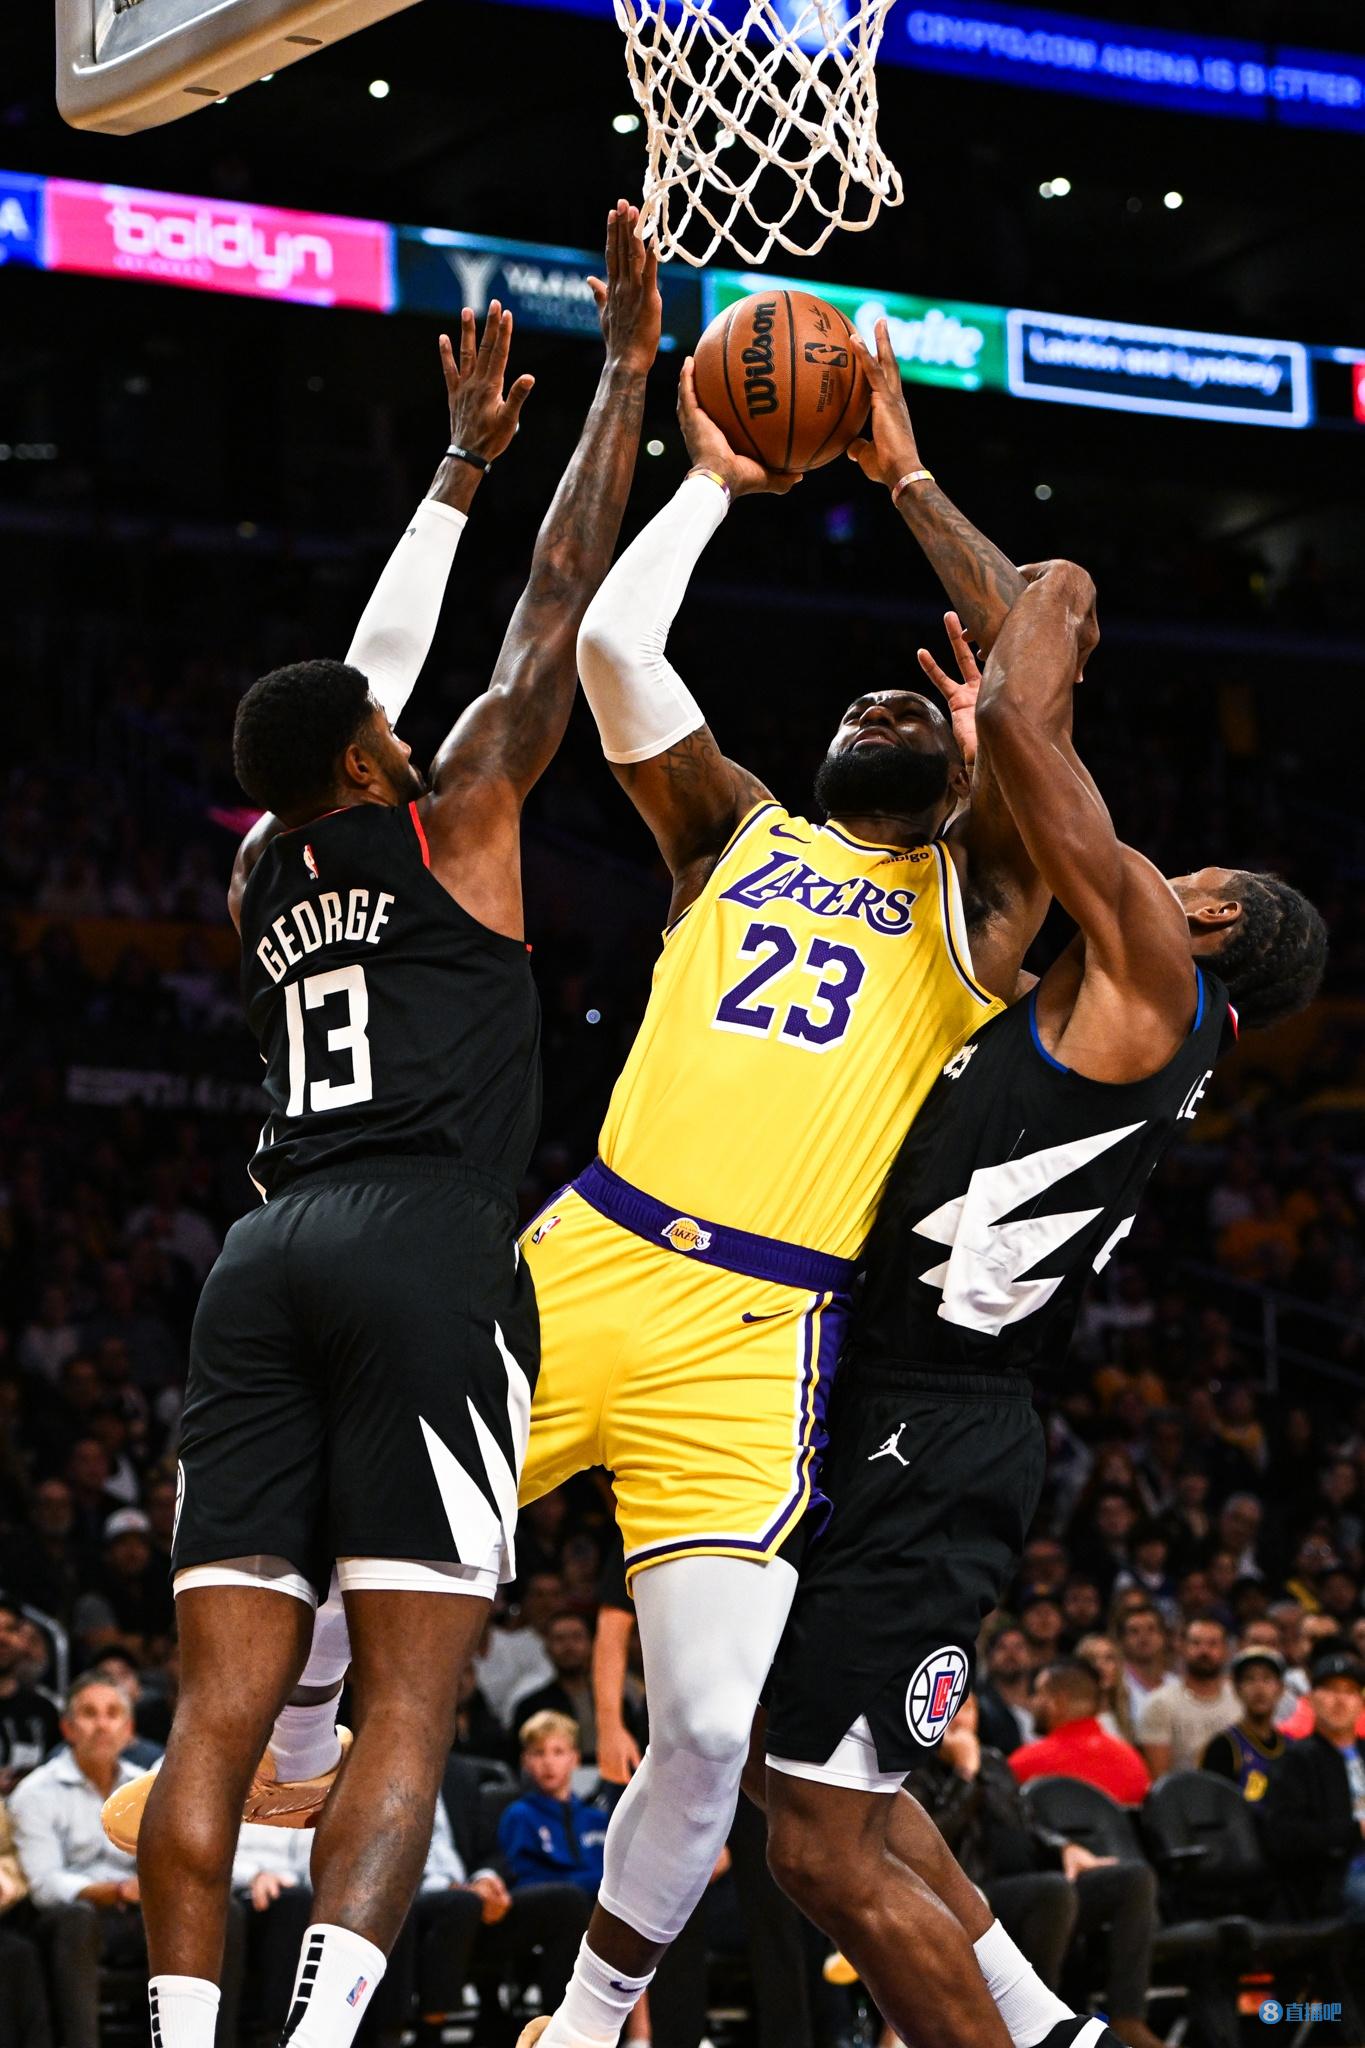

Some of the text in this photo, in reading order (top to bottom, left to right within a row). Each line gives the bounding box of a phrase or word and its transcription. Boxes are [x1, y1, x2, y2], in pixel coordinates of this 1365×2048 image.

[1202, 58, 1236, 92] IS
[106, 201, 333, 289] boldyn
[741, 301, 779, 418] Wilson
[256, 888, 395, 983] GEORGE
[719, 850, 915, 936] LAKERS
[711, 922, 868, 1054] 23
[284, 964, 373, 1118] 13
